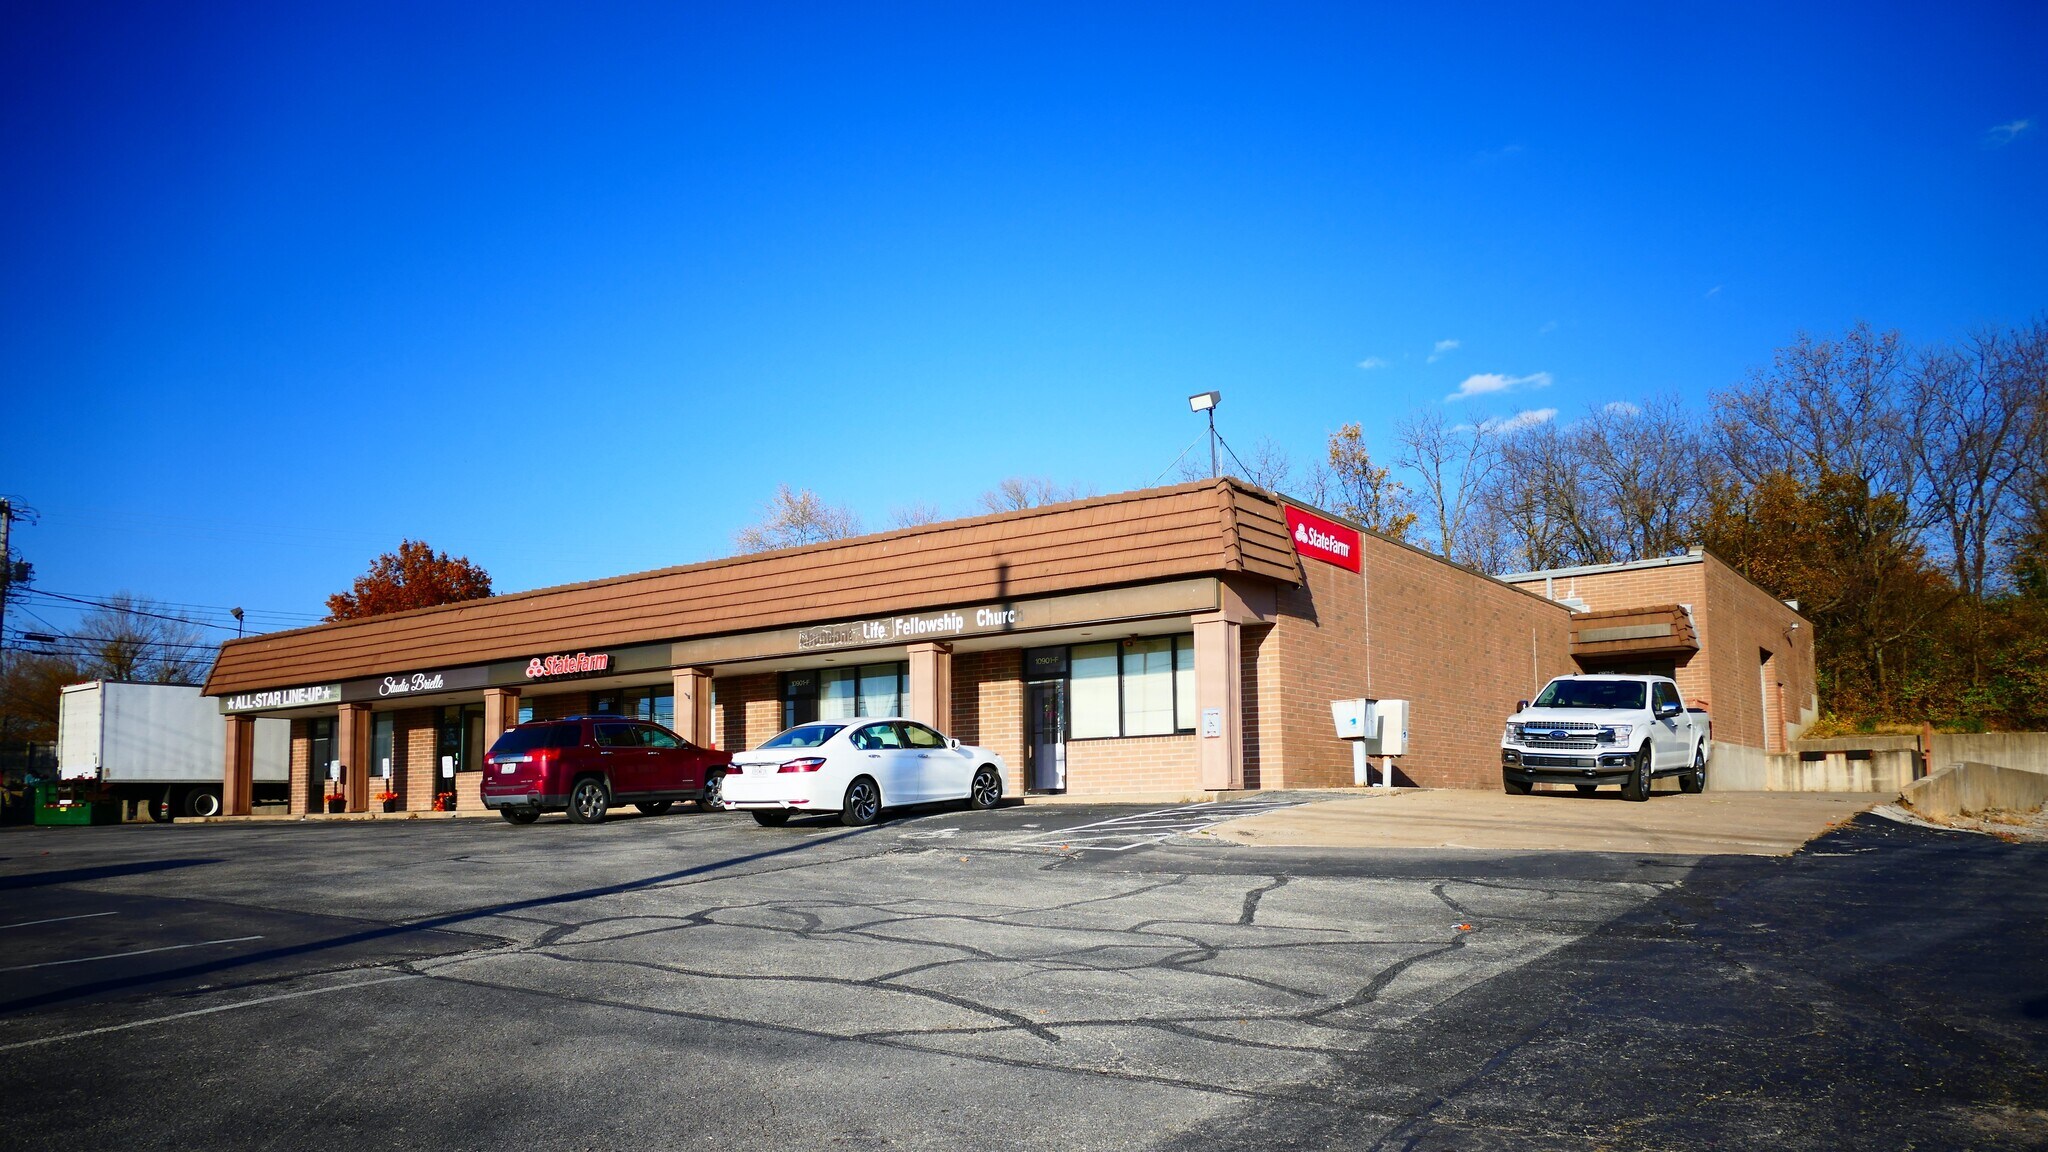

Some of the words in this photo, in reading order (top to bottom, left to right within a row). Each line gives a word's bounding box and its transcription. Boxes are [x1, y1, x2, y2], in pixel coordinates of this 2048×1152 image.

[863, 621, 886, 639] Life
[895, 612, 964, 634] Fellowship
[379, 676, 410, 696] Studio
[411, 673, 444, 691] Brielle
[235, 691, 282, 710] ALL-STAR
[283, 686, 322, 705] LINE-UP
